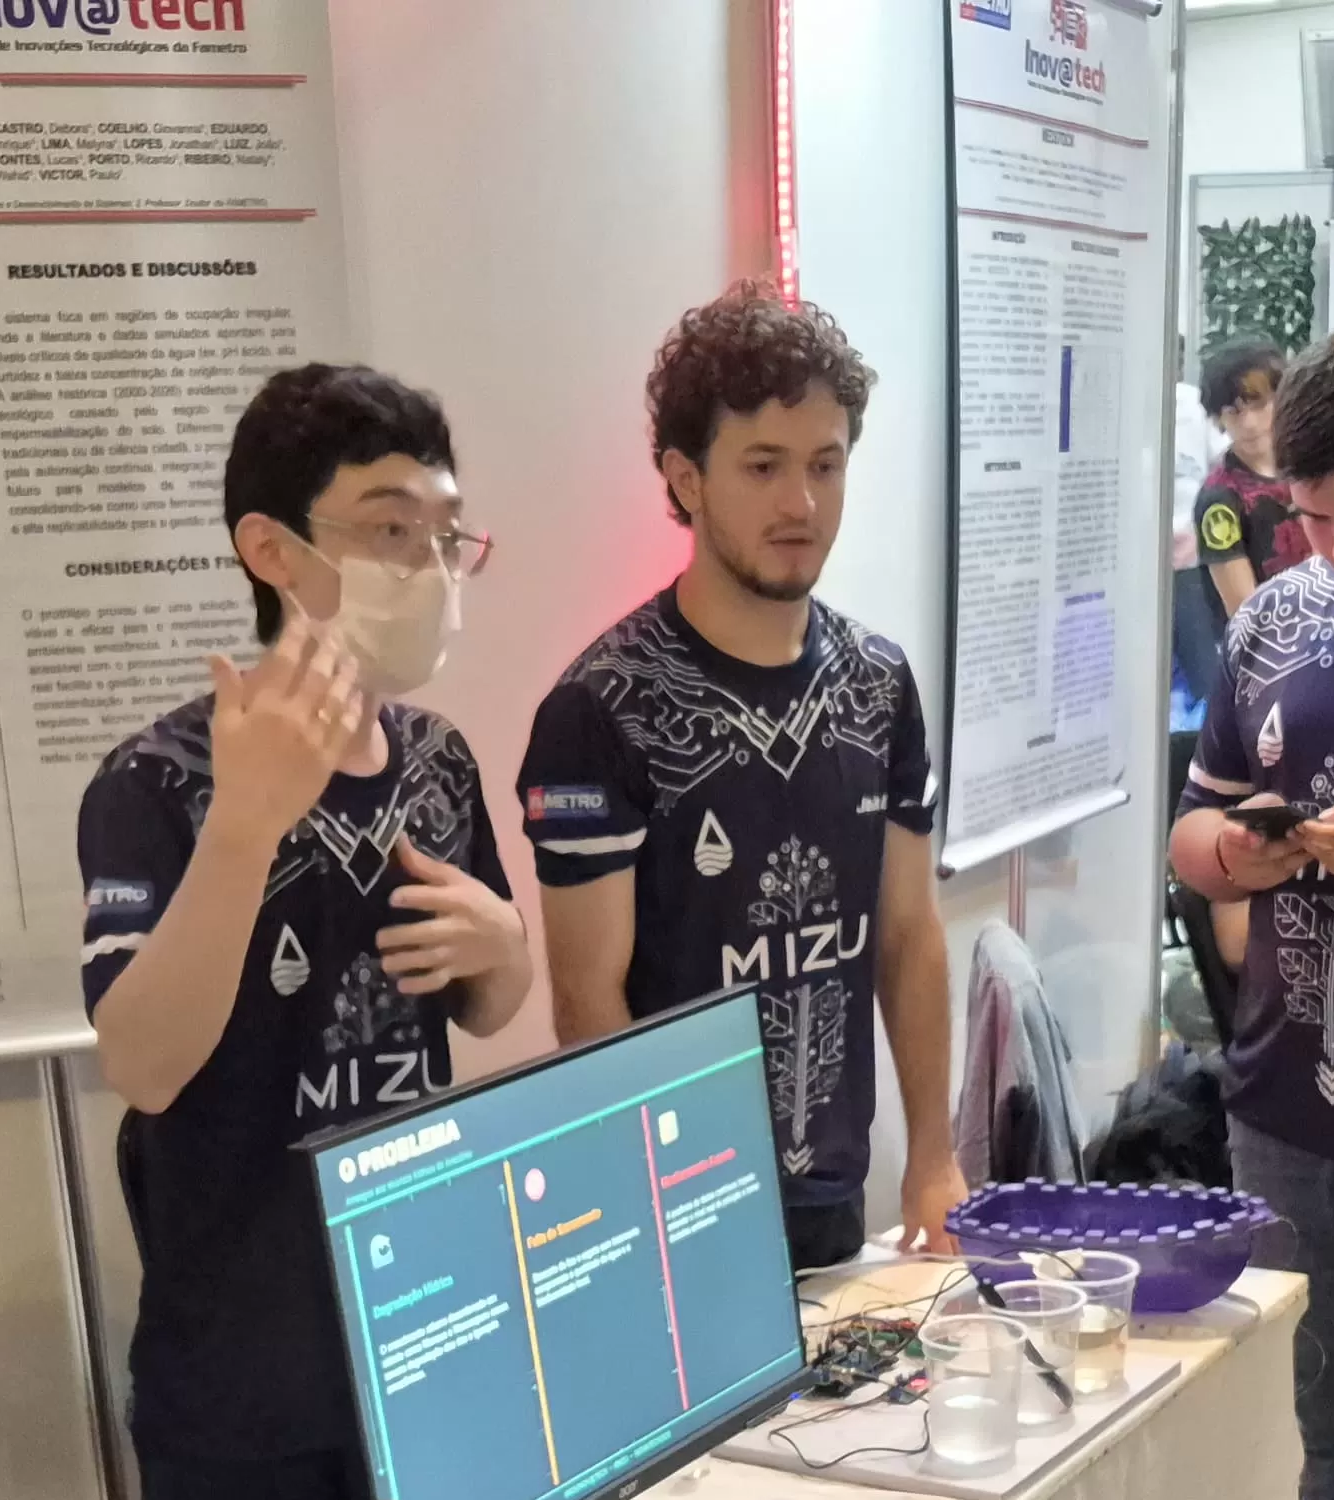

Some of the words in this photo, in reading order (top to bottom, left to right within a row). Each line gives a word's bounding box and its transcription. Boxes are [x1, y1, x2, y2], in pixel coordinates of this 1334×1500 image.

[15, 40, 83, 54] Inovações
[87, 41, 169, 55] Tecnológicas
[173, 42, 190, 53] da
[193, 42, 247, 54] Fametro
[1024, 39, 1106, 95] Inov@tech
[8, 263, 126, 279] RESULTADOS
[132, 263, 143, 278] E
[148, 260, 258, 278] DISCUSSÕES
[65, 556, 210, 578] CONSIDERAÇÕES
[721, 913, 869, 988] MIZU
[339, 1157, 357, 1184] O
[357, 1118, 461, 1177] PROBLEMA
